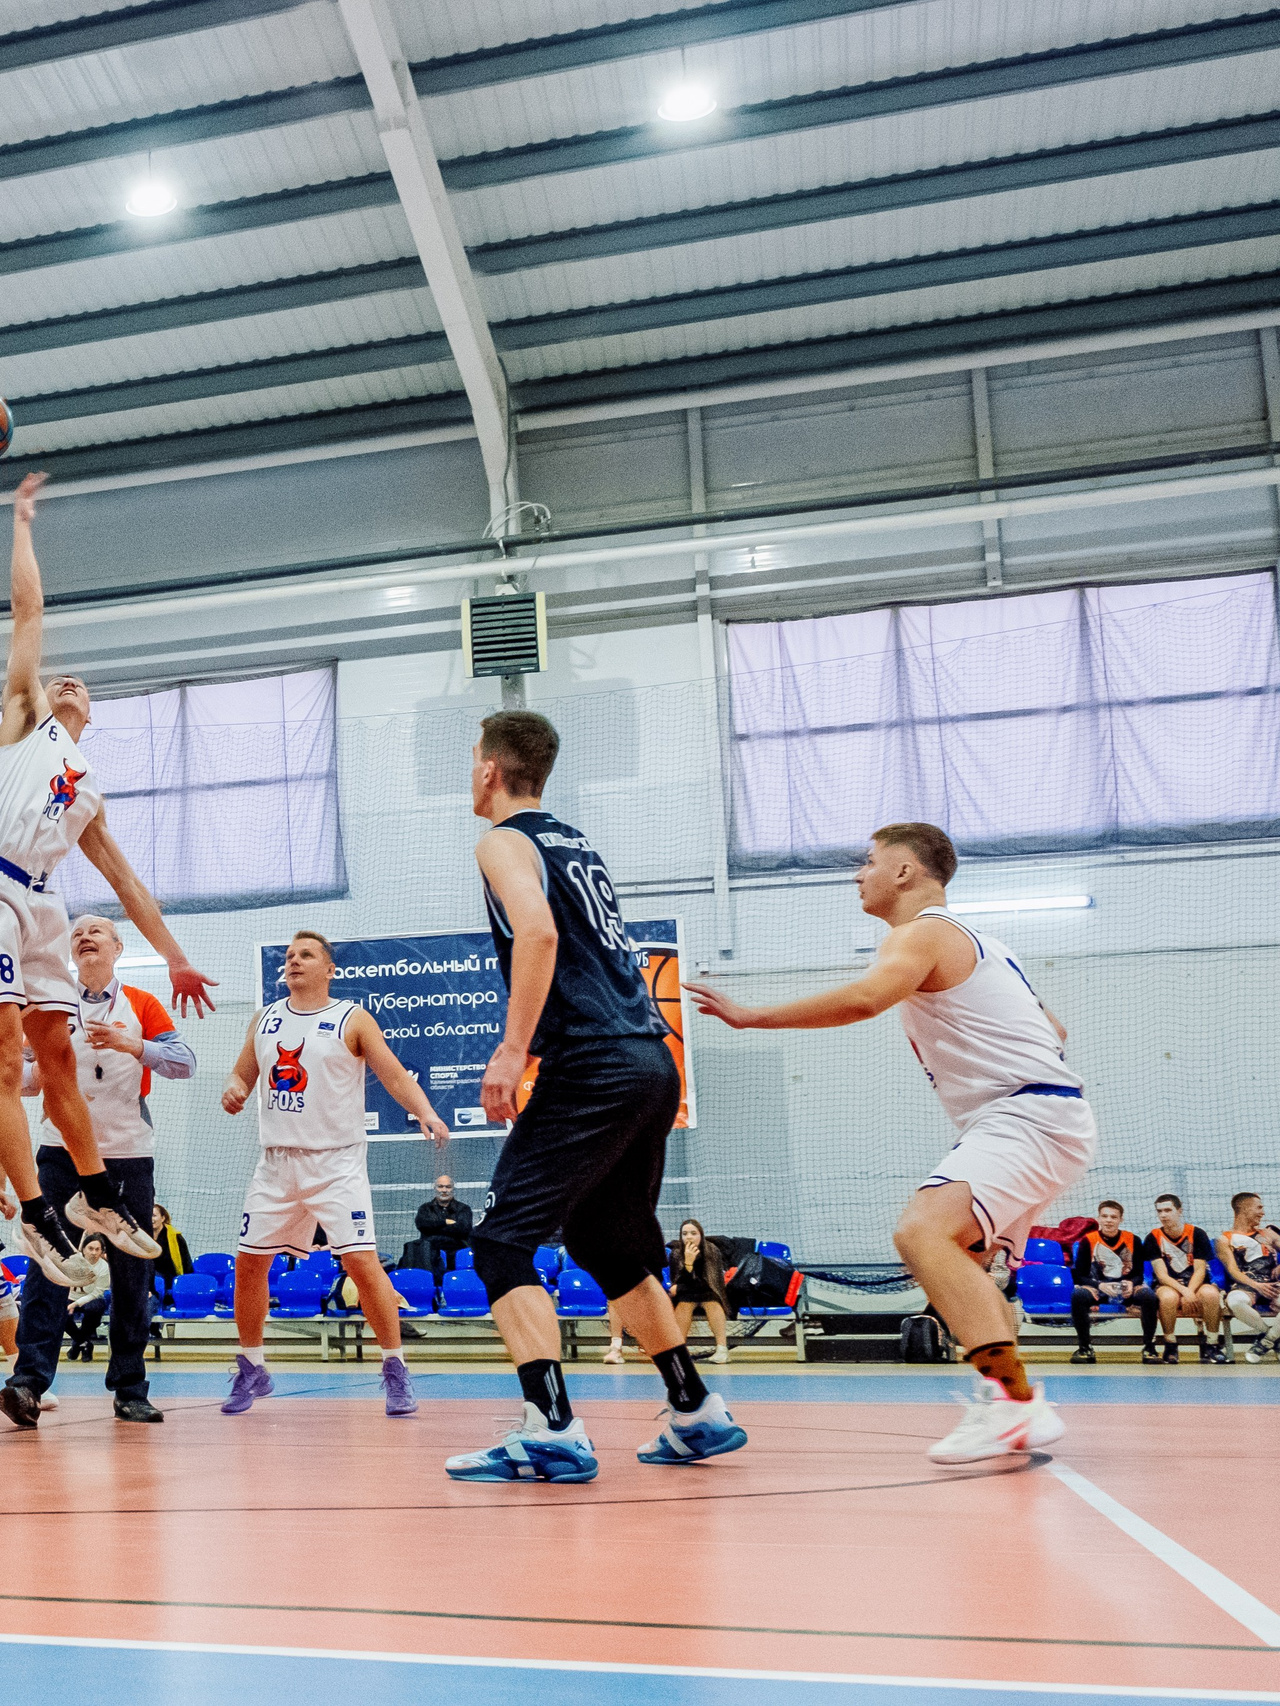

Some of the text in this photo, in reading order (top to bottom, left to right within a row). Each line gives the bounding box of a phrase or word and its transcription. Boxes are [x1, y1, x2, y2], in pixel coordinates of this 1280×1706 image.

[332, 954, 481, 980] аскетбольный
[634, 951, 650, 967] УБ
[368, 990, 498, 1014] Губернатора
[261, 1017, 283, 1035] 13
[383, 1021, 500, 1039] ской области
